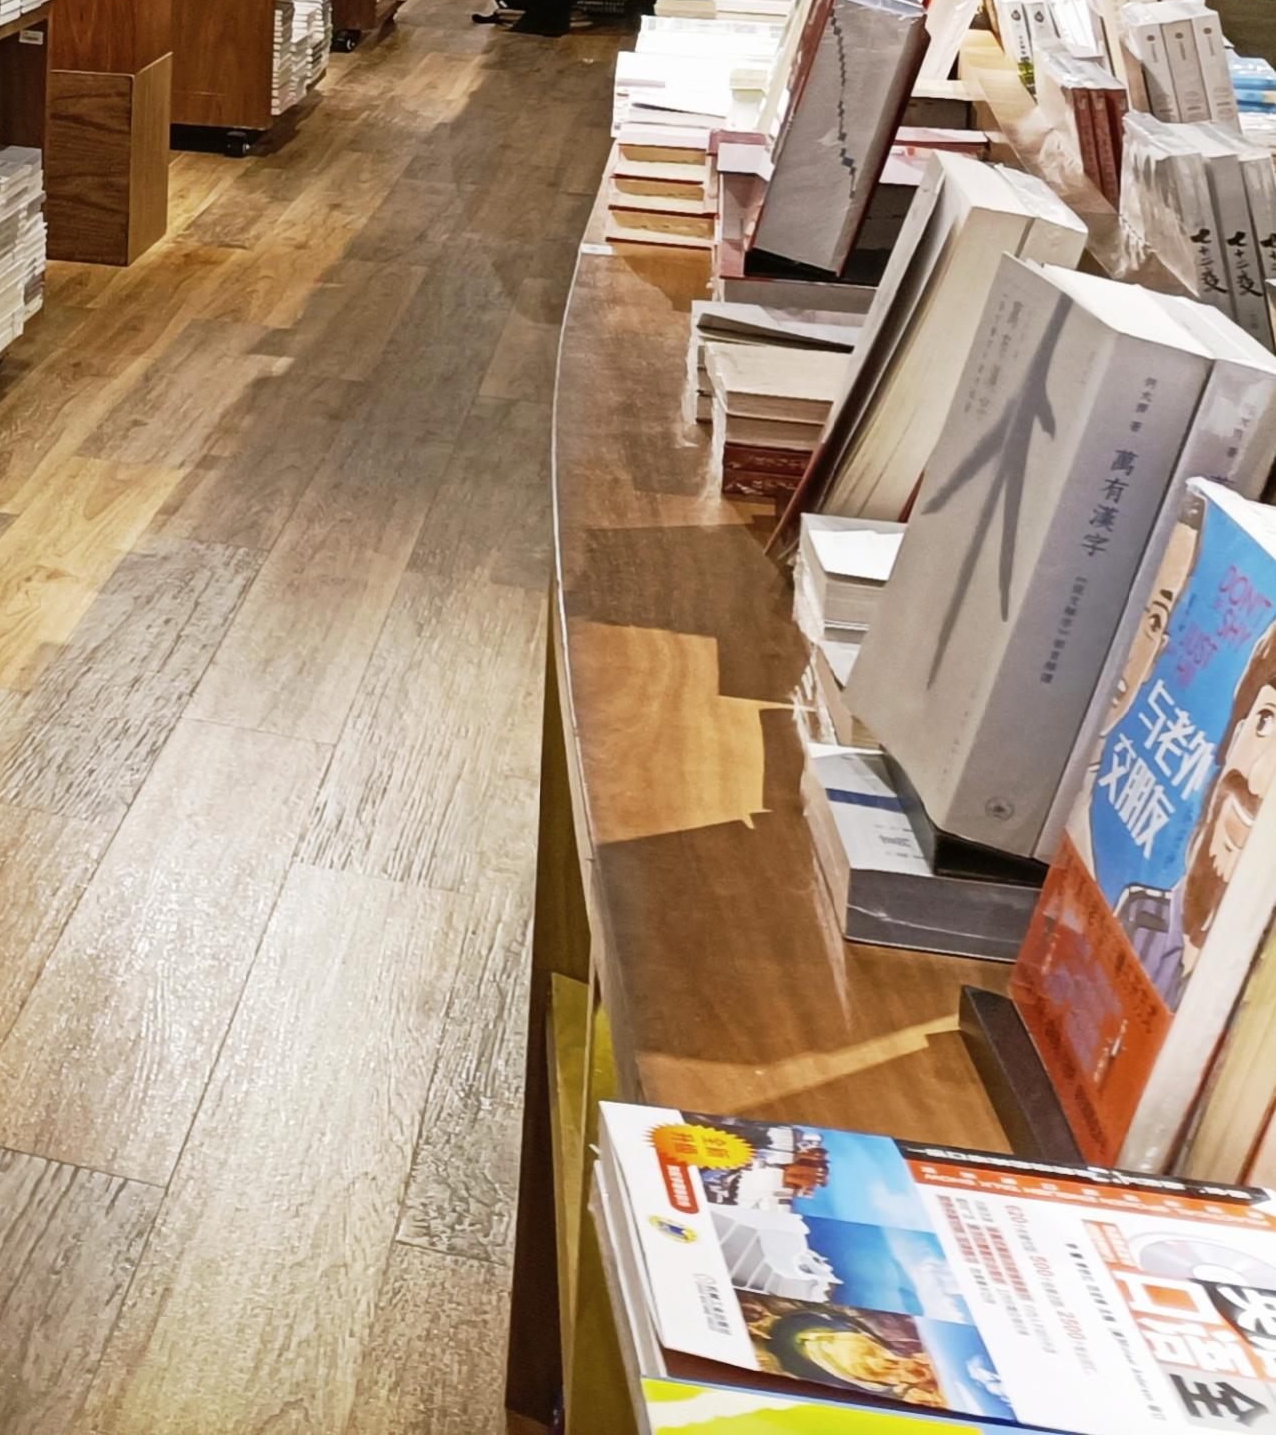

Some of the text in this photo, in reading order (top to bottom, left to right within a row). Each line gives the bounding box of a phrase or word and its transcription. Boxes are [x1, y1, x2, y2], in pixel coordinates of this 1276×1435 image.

[1080, 448, 1139, 558] 萬有漢字
[1137, 678, 1217, 801] 与老外
[1097, 732, 1177, 860] 交朋友
[1112, 1271, 1258, 1379] 口语
[1168, 1371, 1269, 1429] 全
